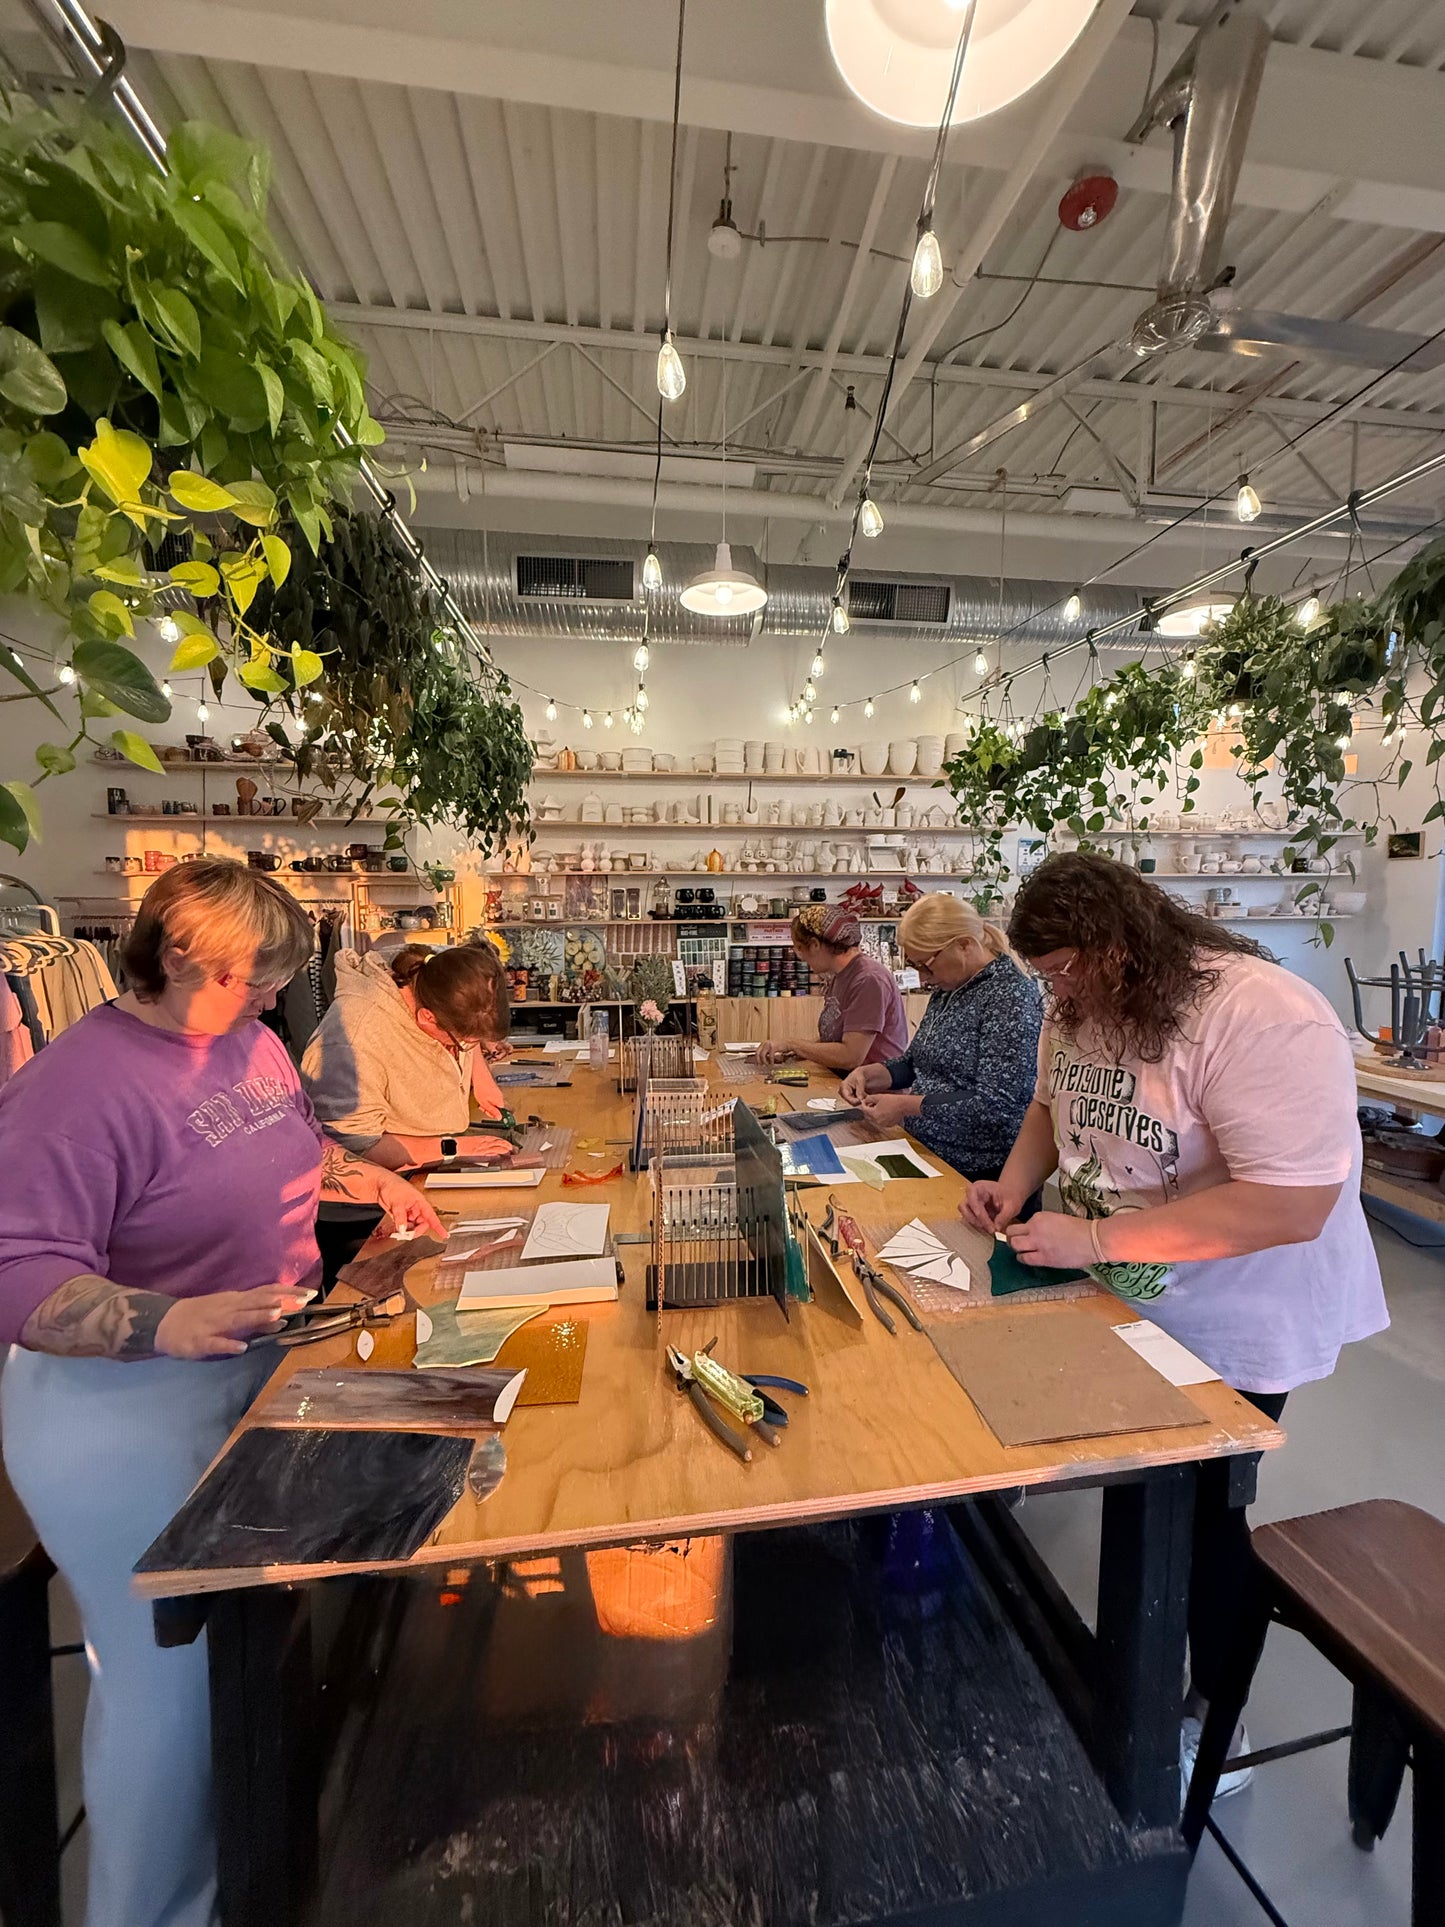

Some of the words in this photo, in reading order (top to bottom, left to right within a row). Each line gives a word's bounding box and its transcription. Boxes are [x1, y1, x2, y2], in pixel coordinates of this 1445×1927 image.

[1050, 1051, 1126, 1100] Everyone
[243, 1110, 287, 1135] CALIFORNIA
[1075, 1095, 1163, 1153] Deserves
[1111, 1263, 1168, 1300] Fly
